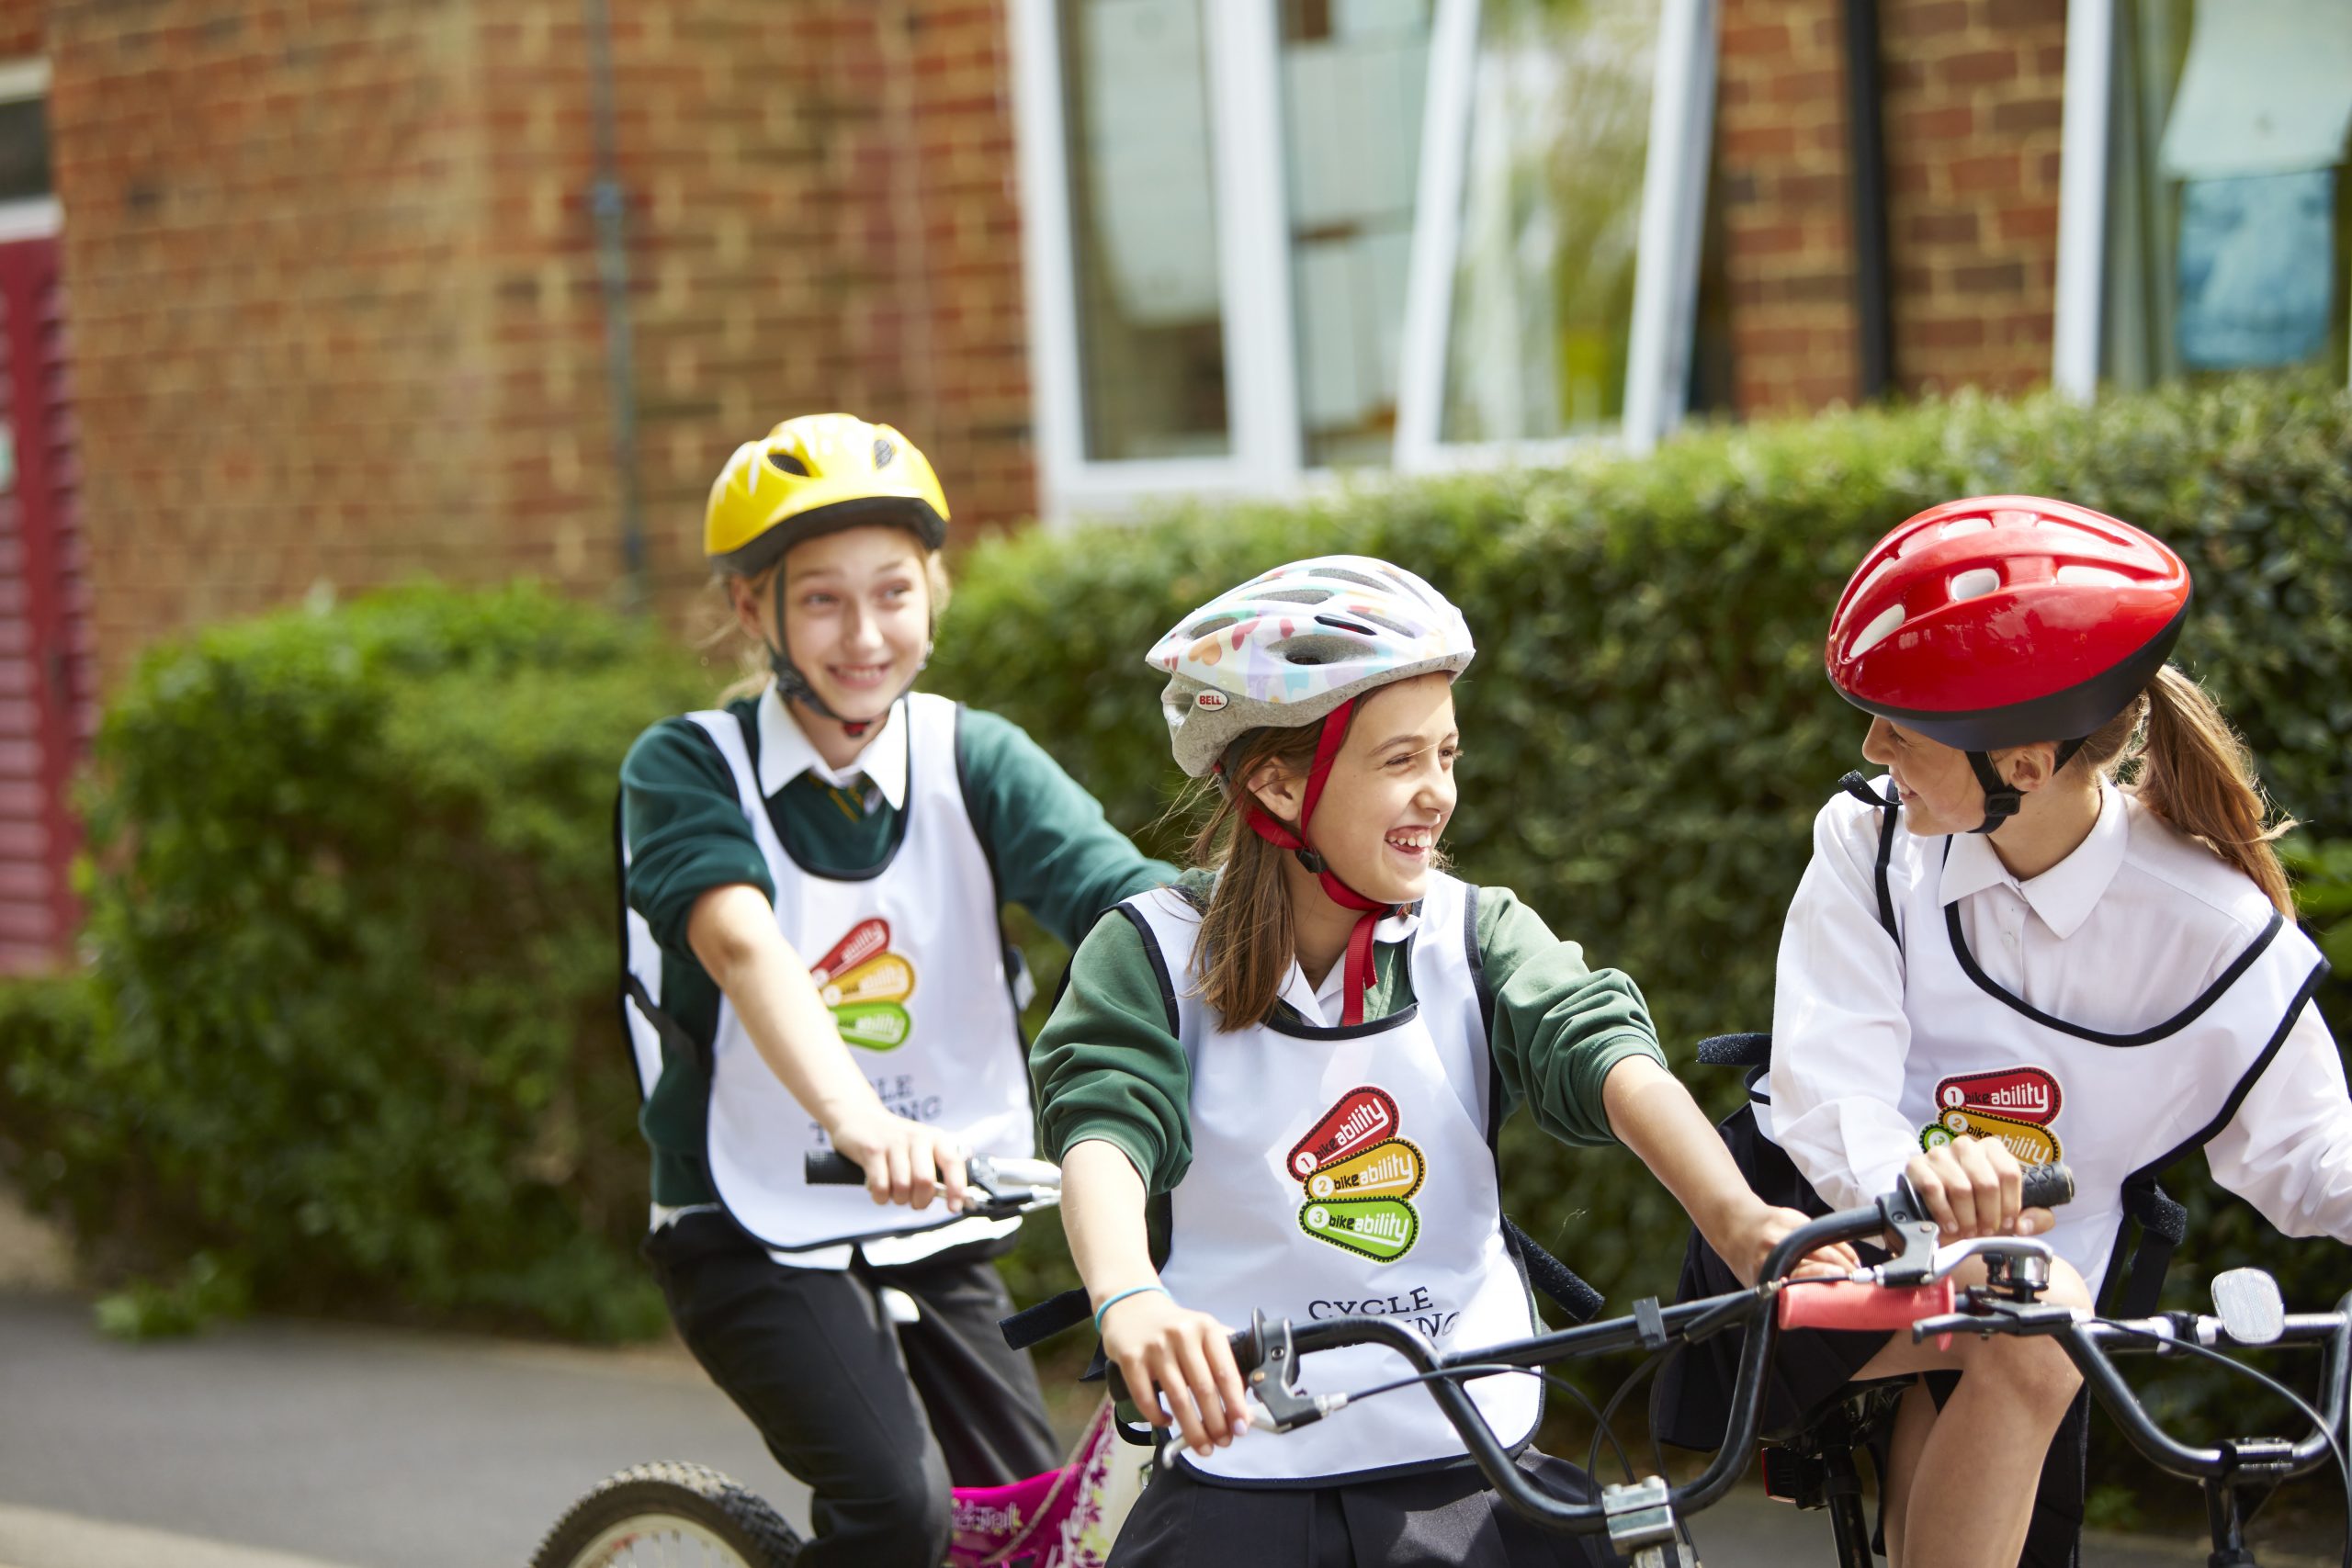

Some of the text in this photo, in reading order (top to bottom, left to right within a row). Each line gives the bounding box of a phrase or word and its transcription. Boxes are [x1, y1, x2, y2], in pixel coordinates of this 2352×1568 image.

[1964, 1082, 2049, 1112] bikeability
[1314, 1098, 1389, 1163] bikeability
[1333, 1154, 1414, 1192] bikeability
[1329, 1213, 1409, 1247] bikeability
